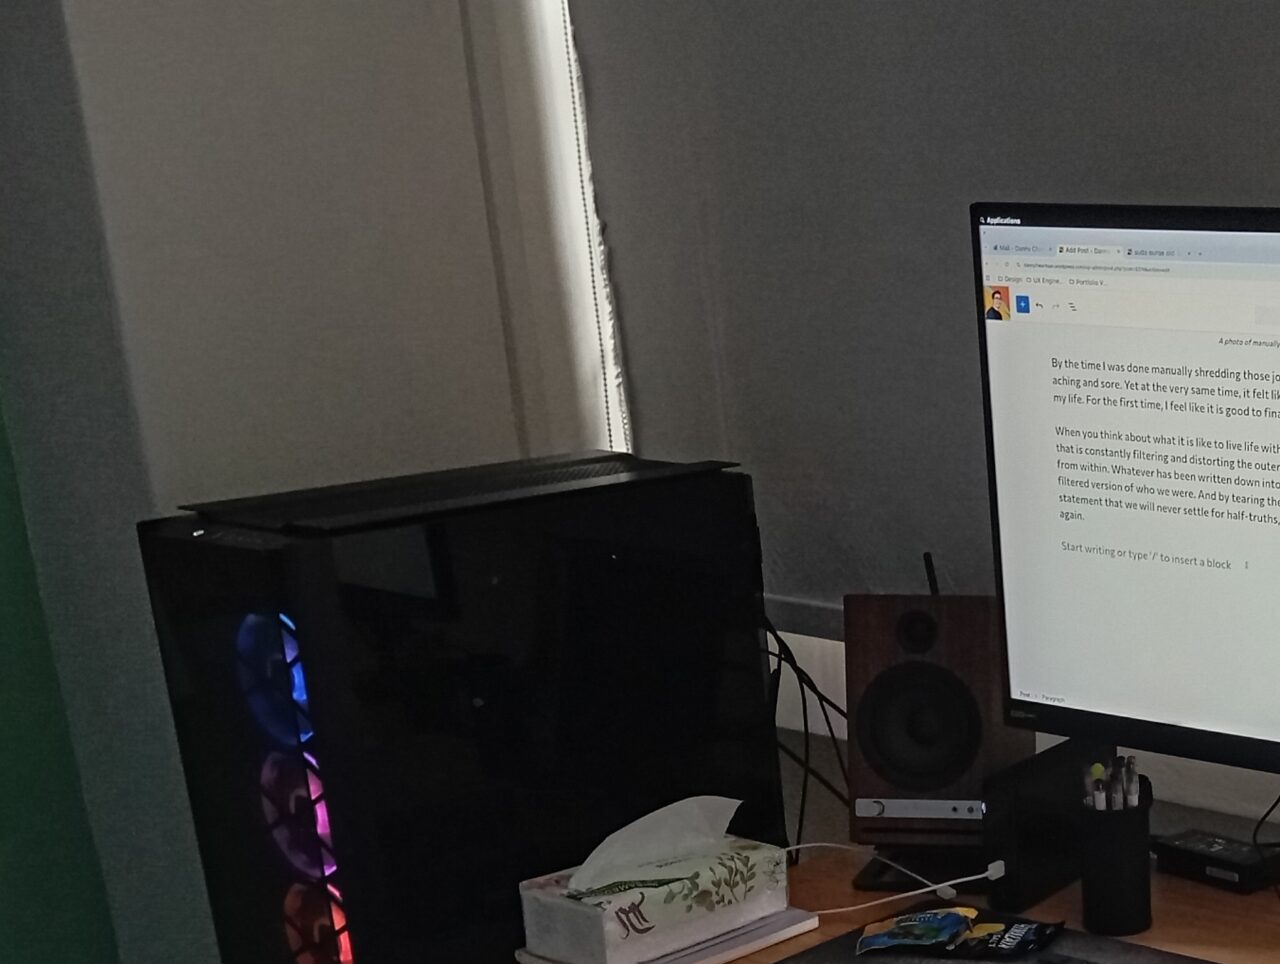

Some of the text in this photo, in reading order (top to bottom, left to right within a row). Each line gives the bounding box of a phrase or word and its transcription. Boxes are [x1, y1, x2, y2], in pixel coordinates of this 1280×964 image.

[986, 217, 1021, 226] Applications
[1223, 338, 1244, 346] photo
[1251, 339, 1280, 349] manually
[1050, 357, 1063, 370] By
[1063, 358, 1080, 370] the
[1080, 359, 1102, 371] time
[1106, 363, 1126, 373] was
[1126, 362, 1150, 374] done
[1150, 365, 1193, 379] manually
[1194, 366, 1241, 383] shredding
[1242, 369, 1271, 382] those
[1055, 442, 1075, 454] that
[1075, 444, 1083, 455] is
[1084, 447, 1132, 461] constantly
[1132, 448, 1169, 465] filtering
[1169, 453, 1188, 464] and
[1188, 453, 1235, 471] distorting
[1236, 458, 1253, 470] the
[1253, 461, 1280, 472] outer
[1056, 458, 1079, 470] from
[1079, 461, 1110, 474] within.
[1110, 464, 1155, 478] Whatever
[1155, 467, 1172, 480] has
[1173, 469, 1197, 482] been
[1196, 472, 1233, 485] written
[1233, 475, 1261, 488] down
[1058, 493, 1103, 507] statement
[1104, 497, 1124, 509] that
[1123, 501, 1138, 510] we
[1138, 500, 1155, 512] will
[1156, 504, 1182, 515] never
[1182, 506, 1210, 520] settle
[1210, 507, 1225, 519] for
[1226, 508, 1280, 526] half-truths,
[1060, 540, 1083, 553] Start
[1083, 544, 1116, 559] writing
[1127, 549, 1148, 561] type
[1148, 551, 1159, 561] '/'
[1171, 556, 1198, 566] insert
[1206, 557, 1232, 570] block
